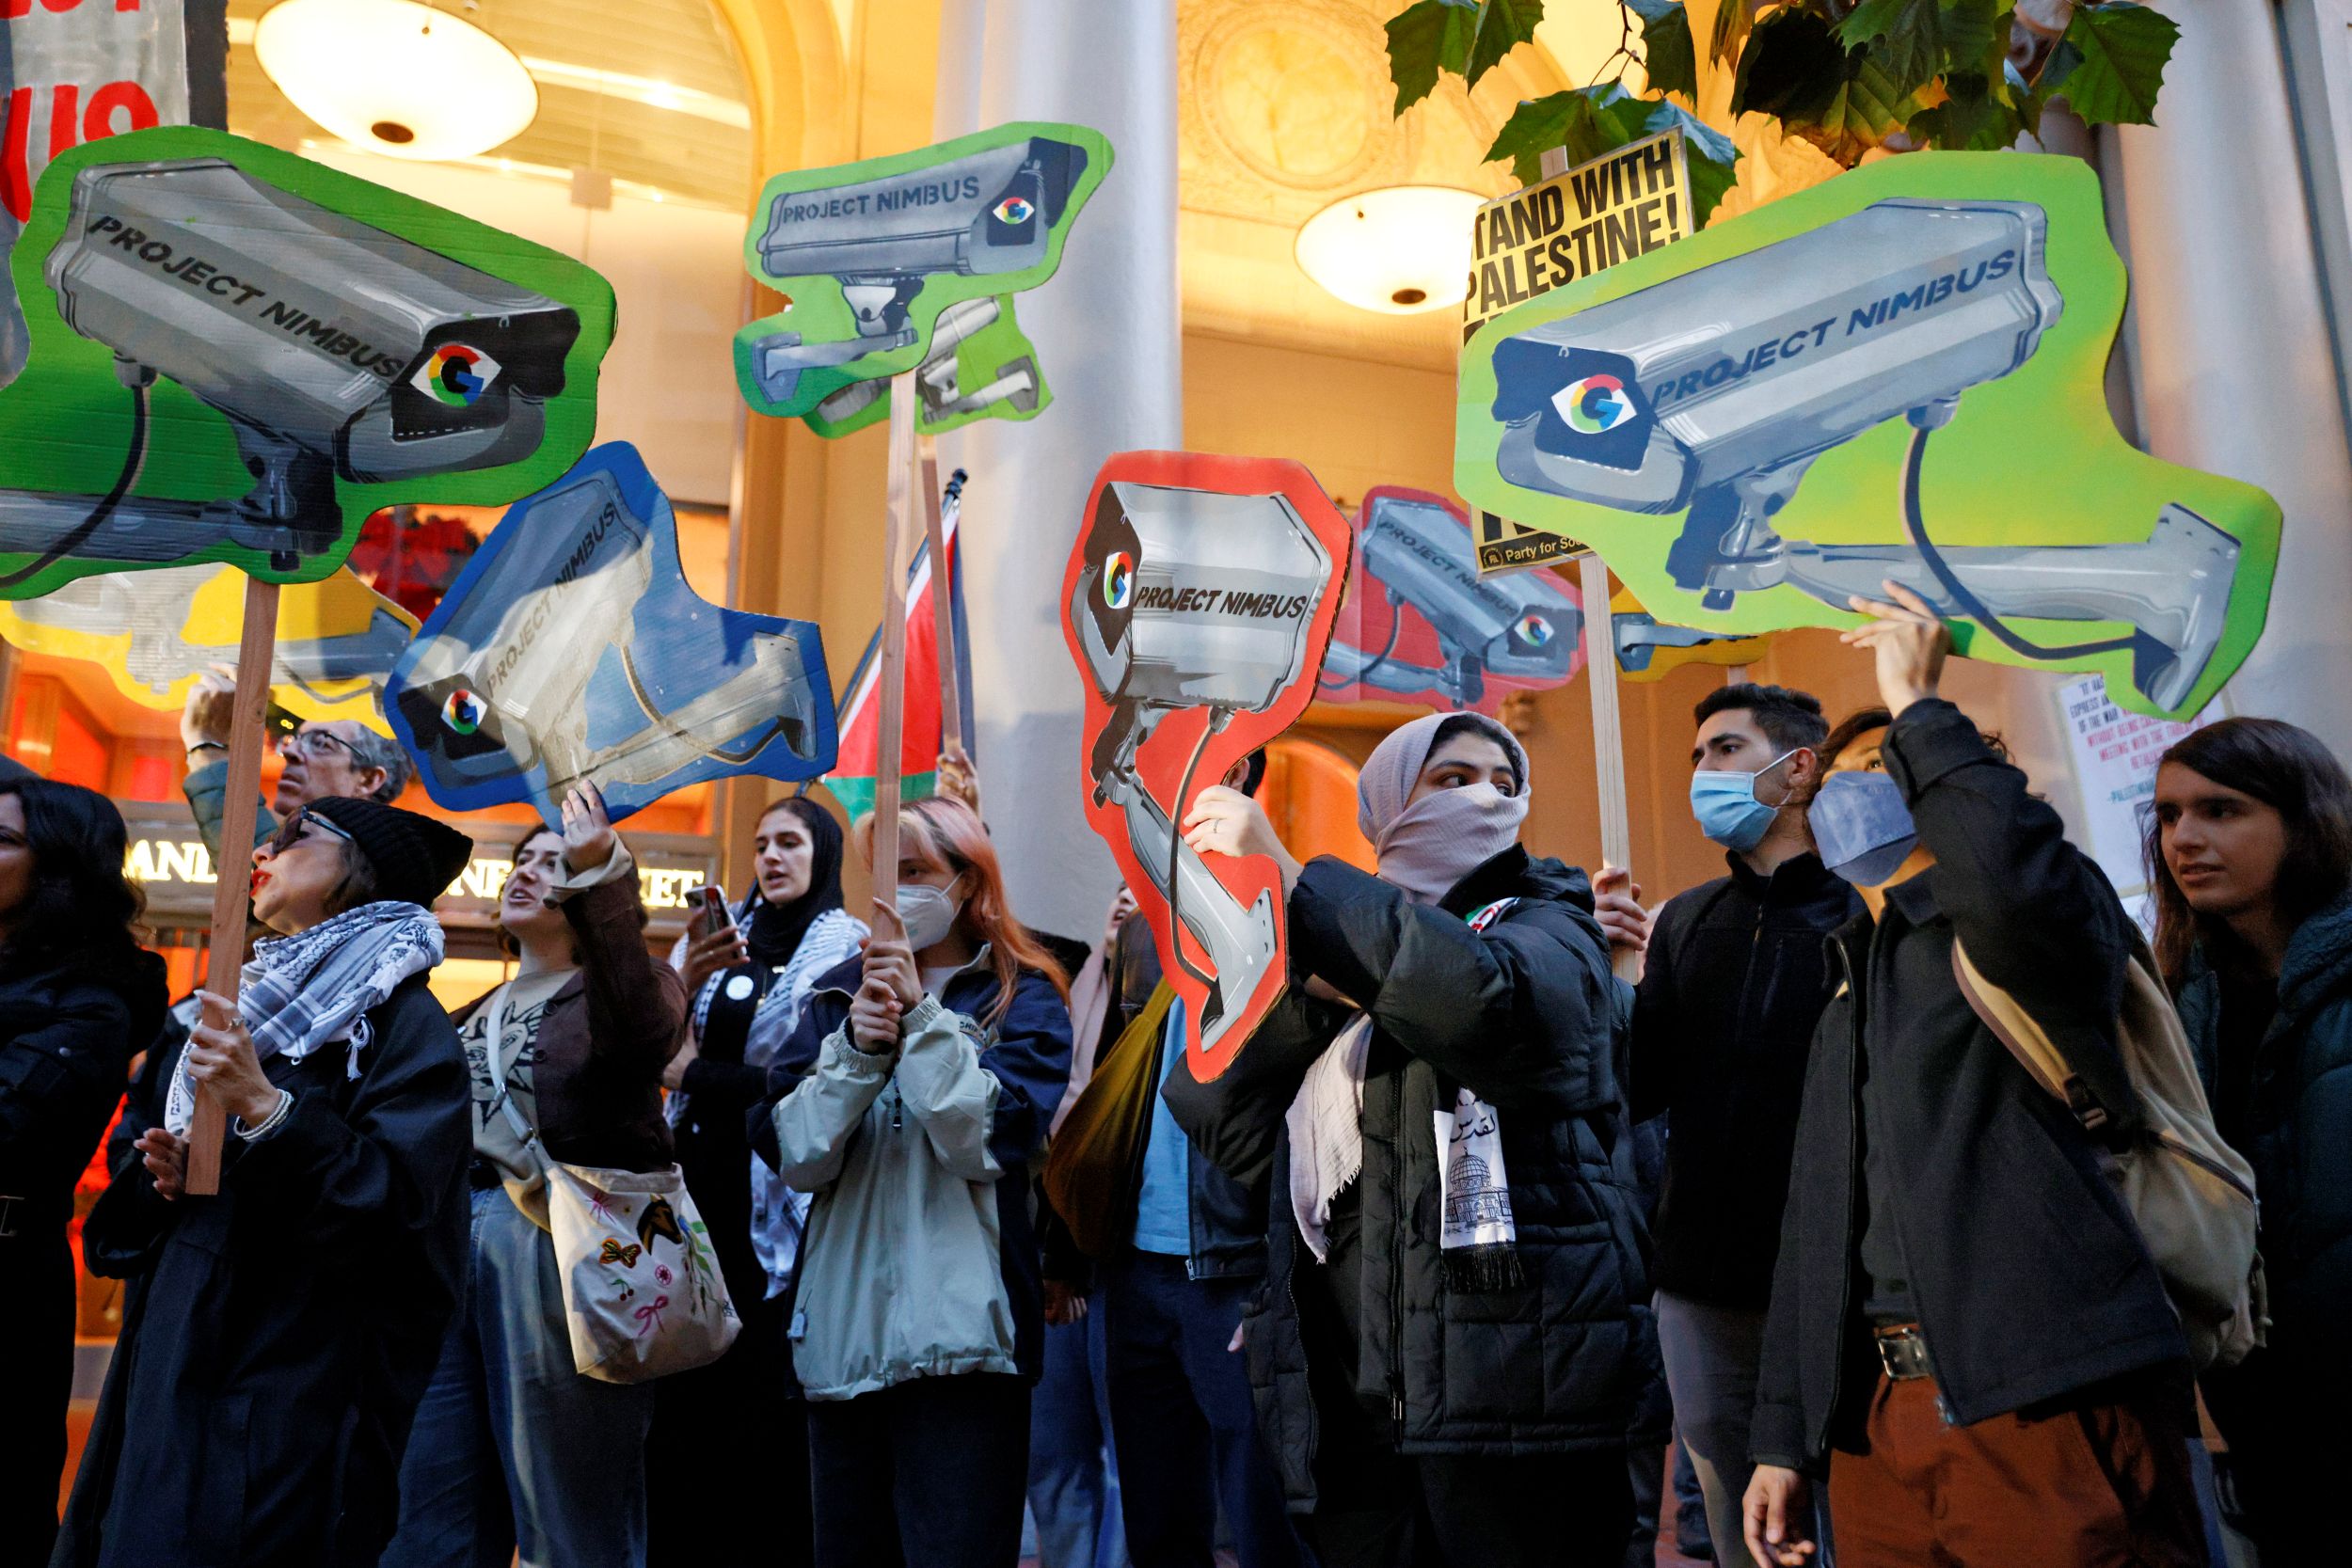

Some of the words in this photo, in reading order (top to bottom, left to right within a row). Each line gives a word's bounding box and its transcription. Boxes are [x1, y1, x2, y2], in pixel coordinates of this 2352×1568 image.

[783, 196, 869, 223] PROJECT
[877, 176, 979, 212] NIMBUS
[1471, 185, 1565, 261] TAND
[1571, 138, 1675, 221] WITH
[87, 215, 265, 305] PROJECT
[259, 301, 404, 376] NIMBUS
[1650, 317, 1837, 409] PROJECT
[1846, 249, 2015, 337] NIMBUS
[485, 594, 551, 698] PROJECT
[553, 501, 615, 597] NIMBUS
[1134, 586, 1222, 612] PROJECT
[1219, 591, 1308, 619] NIMBUS
[1378, 520, 1458, 571] PROJECT
[1455, 571, 1521, 617] NIMBUS
[1505, 546, 1536, 562] Party
[1540, 541, 1557, 554] for
